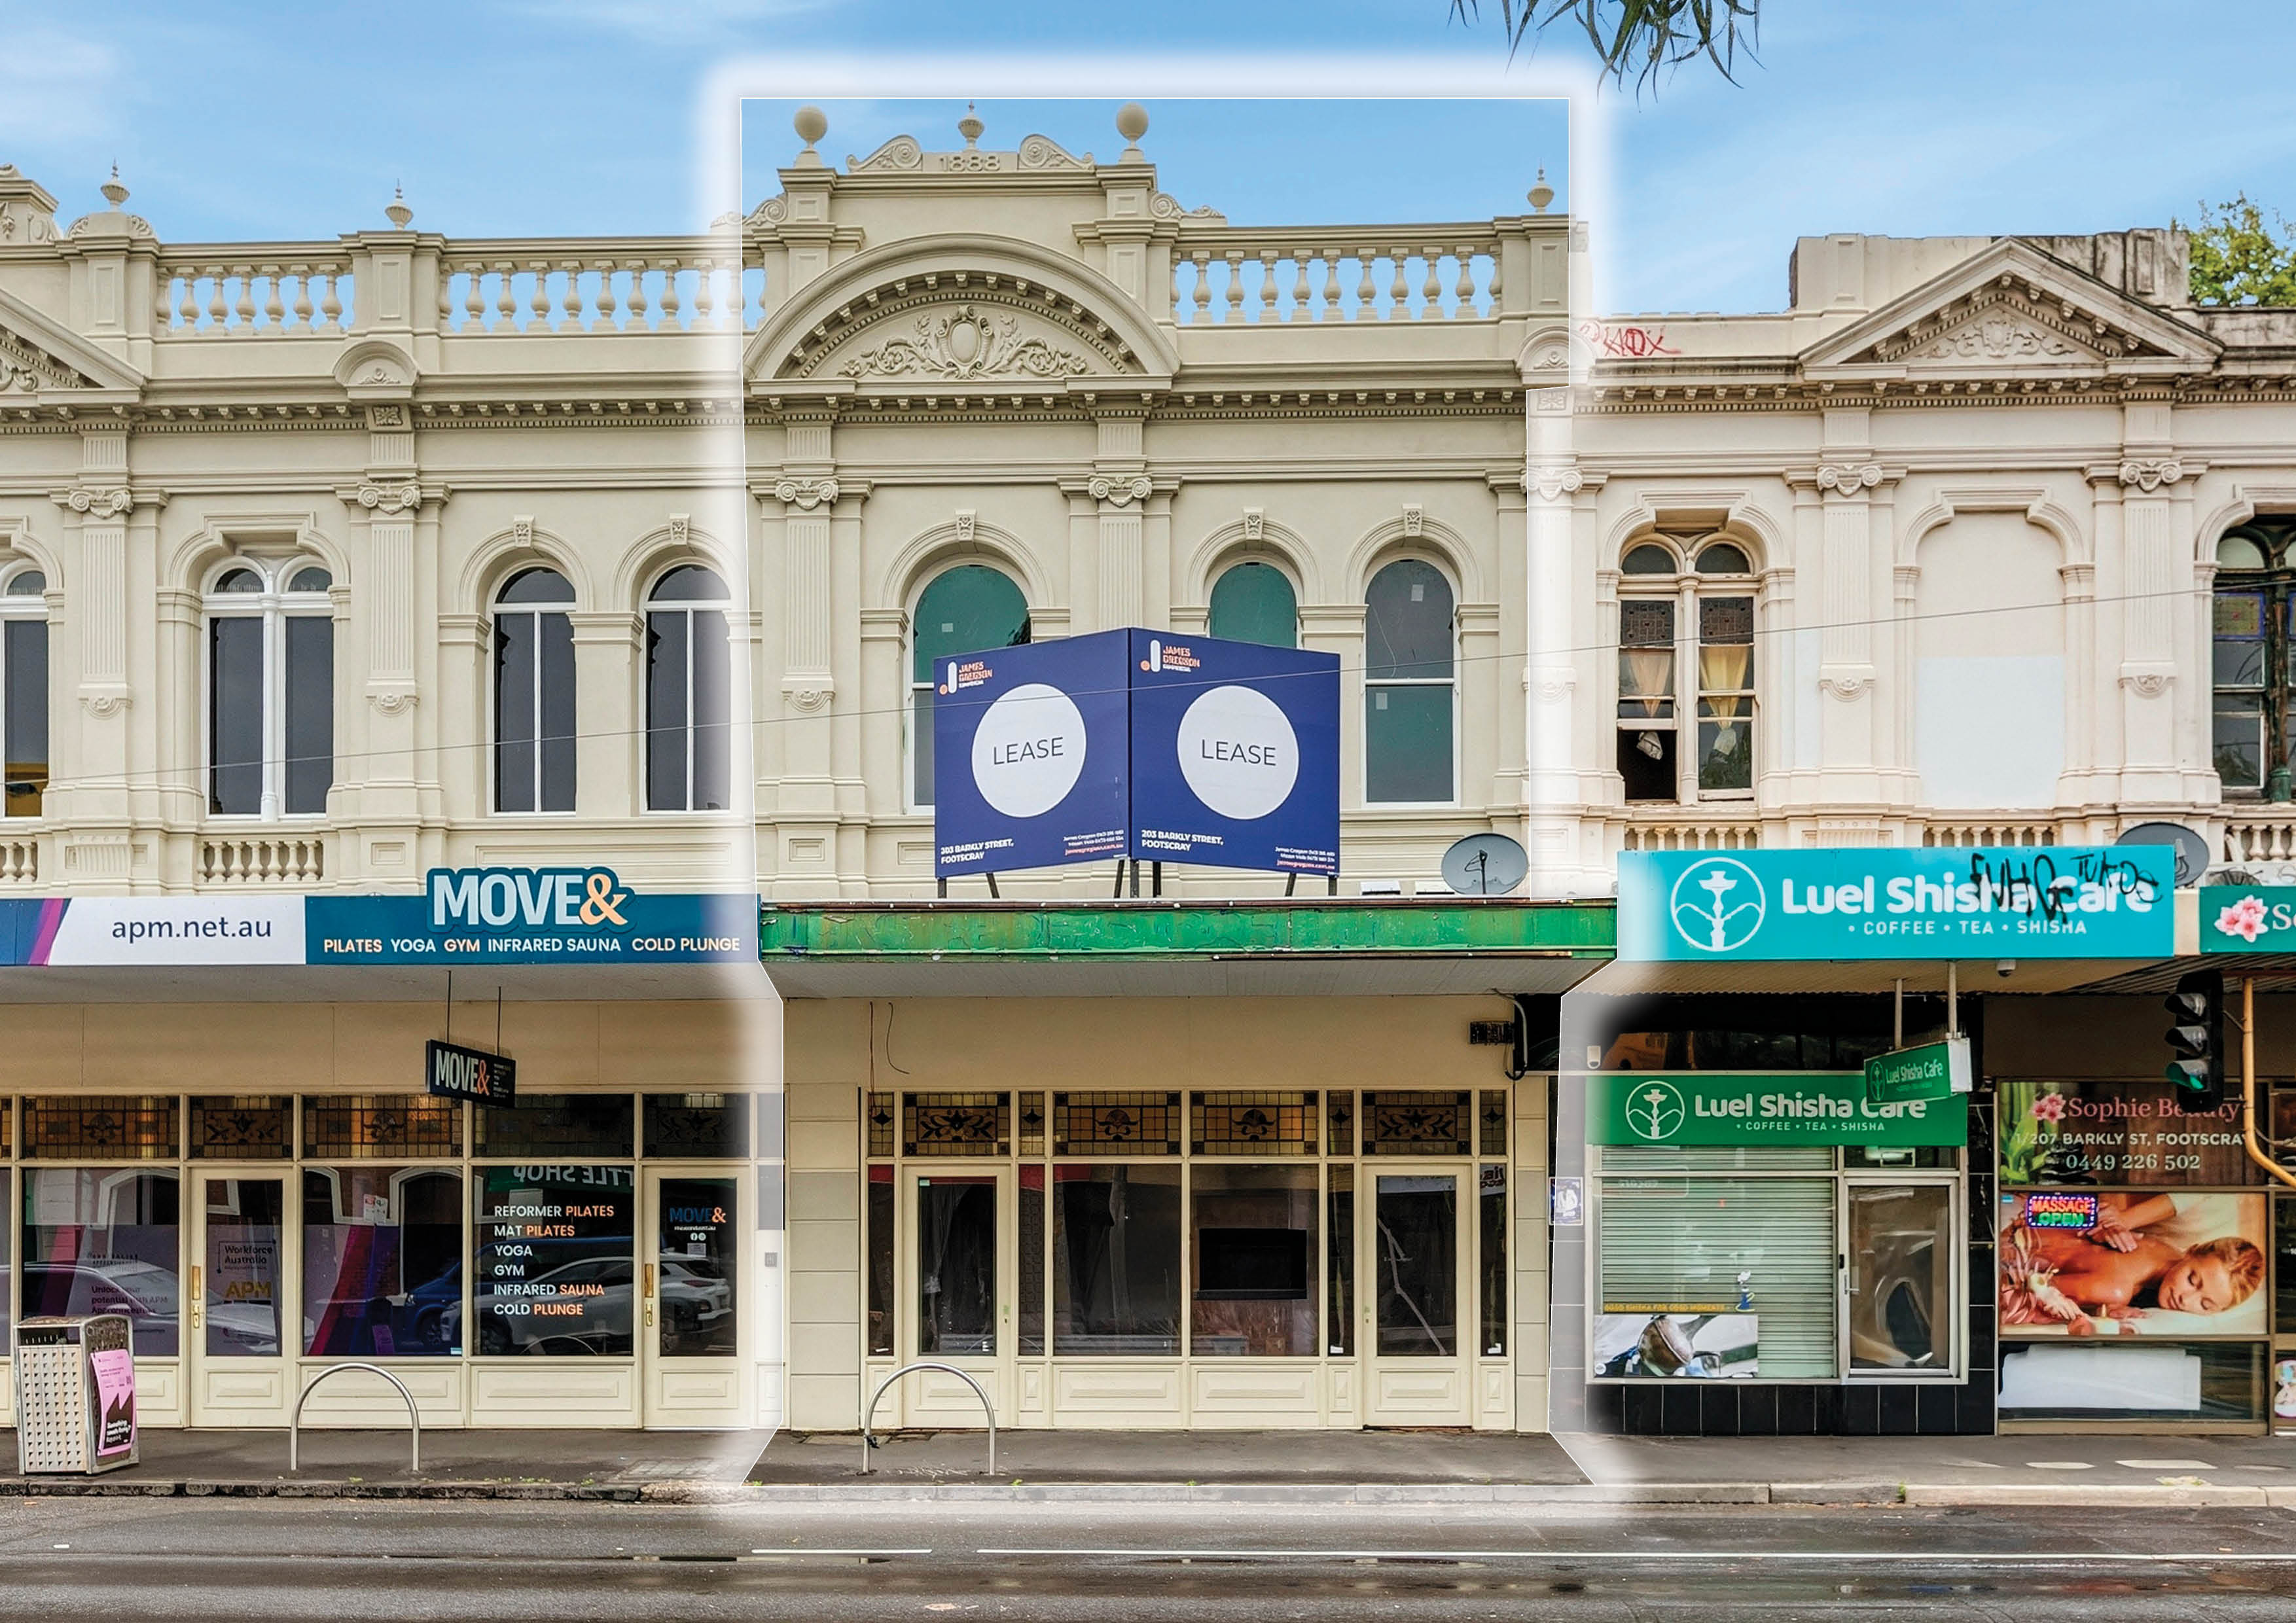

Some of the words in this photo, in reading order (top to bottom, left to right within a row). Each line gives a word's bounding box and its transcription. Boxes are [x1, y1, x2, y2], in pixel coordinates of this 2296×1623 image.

[939, 154, 1000, 171] 1888
[1162, 645, 1191, 656] JAMES
[959, 661, 984, 673] JAMES
[994, 736, 1063, 765] LEASE
[1202, 739, 1276, 766] LEASE
[1141, 829, 1157, 838] 203
[941, 851, 984, 864] FOOTSCRAY
[433, 873, 628, 925] MOVE&
[1782, 875, 1874, 914] Luel
[2272, 903, 2296, 930] S
[112, 917, 272, 944] apm.net.au
[1863, 921, 1935, 935] COFFEE
[1959, 920, 1994, 935] TEA
[2017, 920, 2087, 935] SHISHA
[323, 938, 383, 953] PILATES
[390, 938, 437, 952] YOGA
[443, 938, 480, 952] GYM
[488, 938, 563, 952] INFRARED
[567, 937, 621, 952] SAUNA
[632, 937, 675, 952] COLD
[681, 937, 740, 952] PLUNGE
[435, 1048, 490, 1096] MOVE&
[1924, 1058, 1943, 1078] Cafe
[1695, 1094, 1753, 1117] Luel
[1760, 1092, 1854, 1118] Shisha
[2069, 1097, 2151, 1123] Sophie
[2157, 1098, 2240, 1123] Bety
[1746, 1121, 1791, 1131] COFFEE
[1805, 1121, 1827, 1131] TEA
[1840, 1121, 1885, 1131] SHISHA
[2062, 1133, 2125, 1145] BARKLY
[2129, 1133, 2151, 1147] ST,
[2066, 1154, 2116, 1170] 0449
[2122, 1154, 2159, 1169] 226
[2164, 1154, 2201, 1169] 502
[493, 1205, 562, 1217] REFORMER
[565, 1205, 614, 1217] PILATES
[2032, 1199, 2091, 1213] MASSAGE
[2038, 1212, 2084, 1226] OPEN
[494, 1225, 522, 1237] MAT
[526, 1224, 575, 1237] PILATES
[224, 1245, 273, 1255] Workforce
[495, 1245, 533, 1257] YOGA
[494, 1264, 524, 1277] GYM
[225, 1281, 272, 1299] APM
[493, 1284, 556, 1296] INFRARED
[560, 1284, 605, 1296] SAUNA
[493, 1304, 530, 1315] COLD
[534, 1304, 584, 1315] PLUNGE
